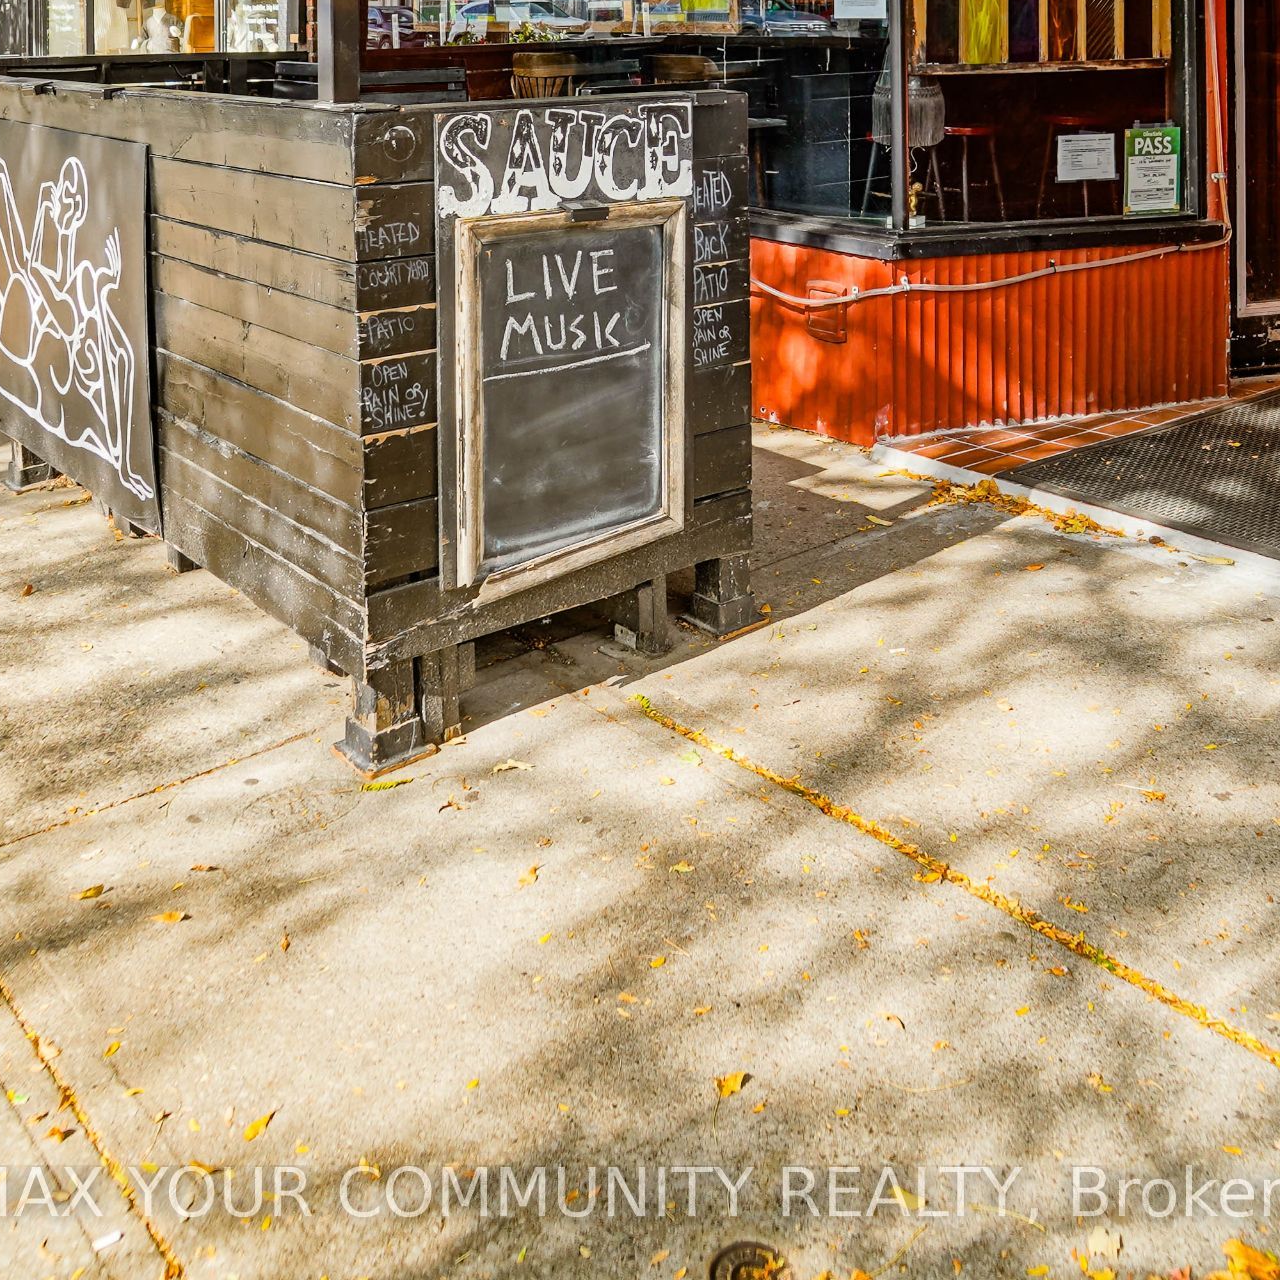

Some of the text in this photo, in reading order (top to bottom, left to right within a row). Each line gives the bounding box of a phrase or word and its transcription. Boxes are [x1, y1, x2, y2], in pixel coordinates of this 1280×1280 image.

[439, 102, 693, 219] SAUCE
[1134, 136, 1172, 155] PASS
[360, 223, 420, 253] HEATED
[694, 225, 729, 265] BACK
[505, 249, 618, 306] LIVE
[694, 267, 728, 304] PATIO
[368, 316, 415, 345] PATIO
[500, 311, 621, 361] MUSIC
[718, 325, 732, 340] OR
[693, 341, 731, 367] SHINE
[372, 362, 408, 387] OPEN
[363, 382, 424, 412] RAIN OR
